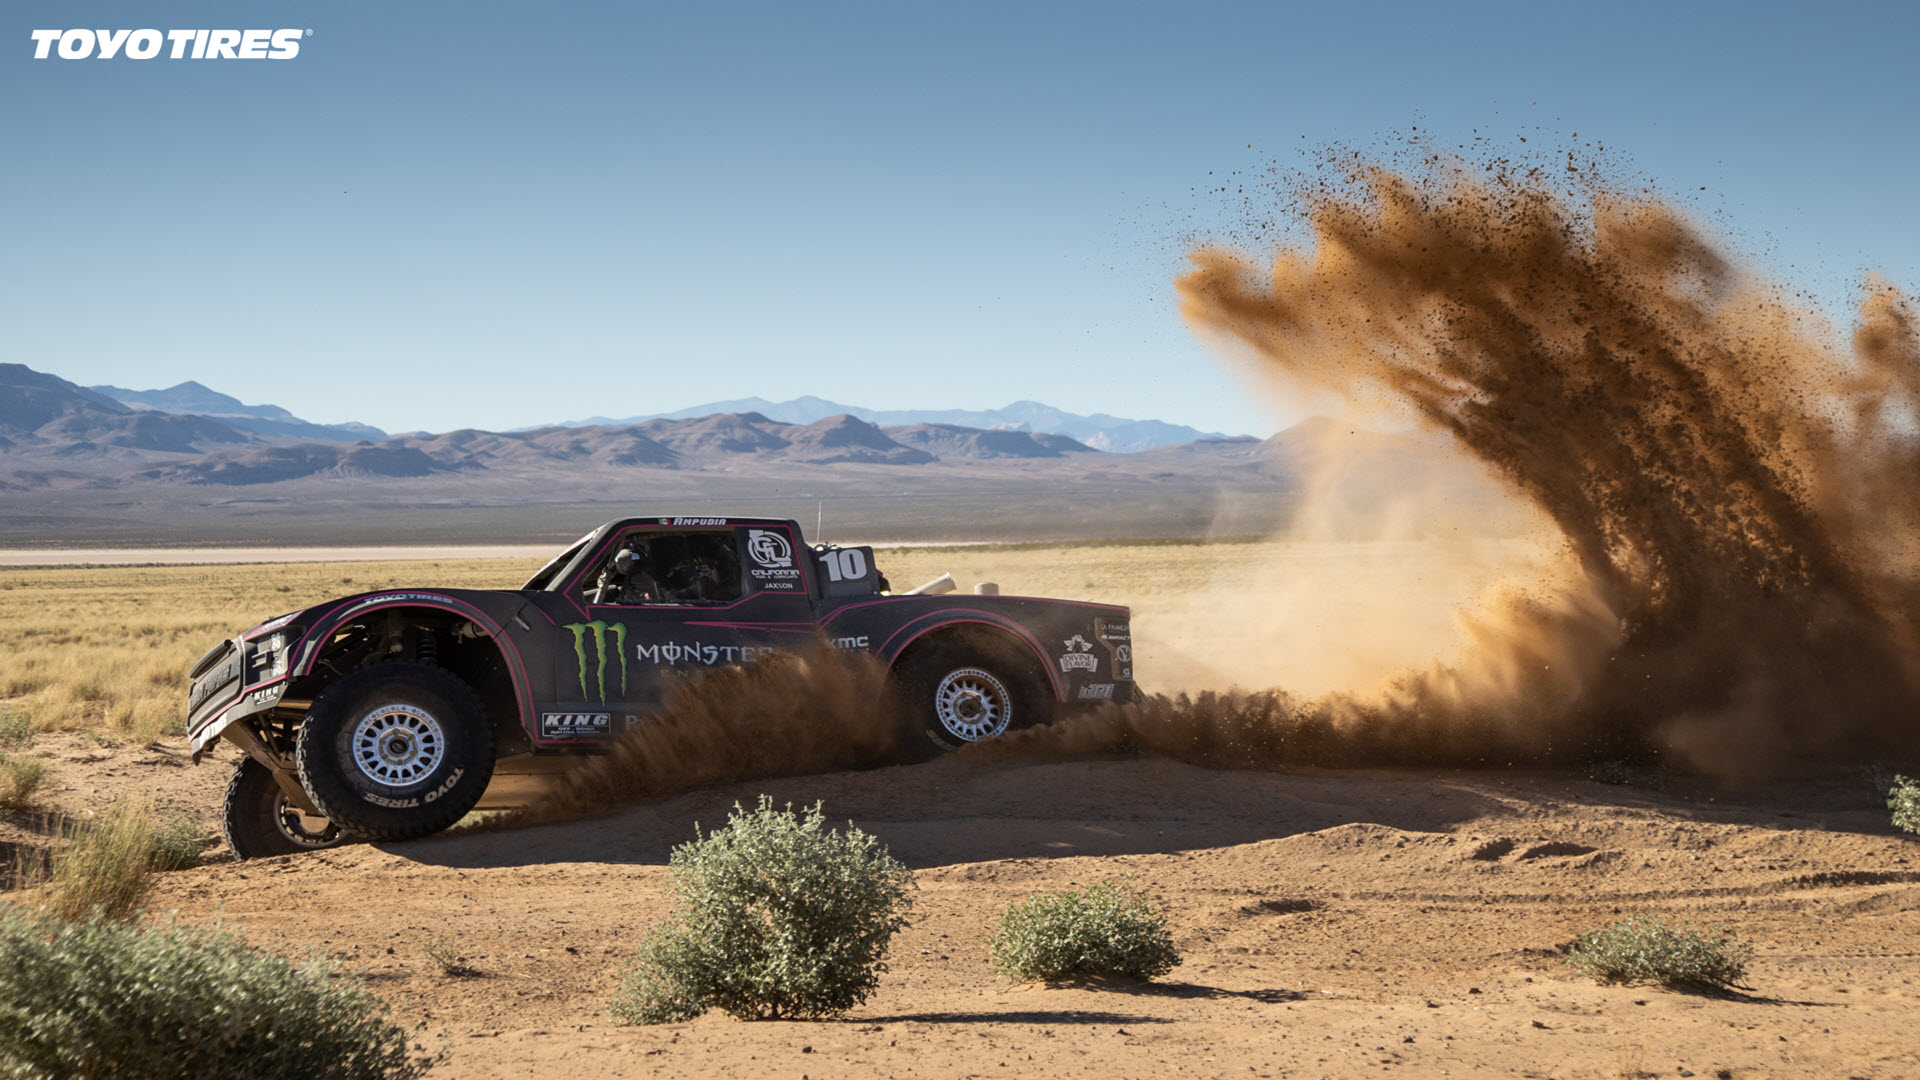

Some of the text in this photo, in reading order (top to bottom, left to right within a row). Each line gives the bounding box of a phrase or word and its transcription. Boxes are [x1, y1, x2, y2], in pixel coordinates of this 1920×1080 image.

[673, 517, 727, 526] AMPUDIA
[819, 549, 867, 582] 10
[364, 593, 453, 604] TOYO TIRES
[1065, 653, 1093, 661] DIVINE
[1065, 660, 1093, 668] FLAVOR
[254, 686, 279, 701] KING
[545, 715, 608, 726] KING
[362, 767, 464, 809] TOYO TIRES
